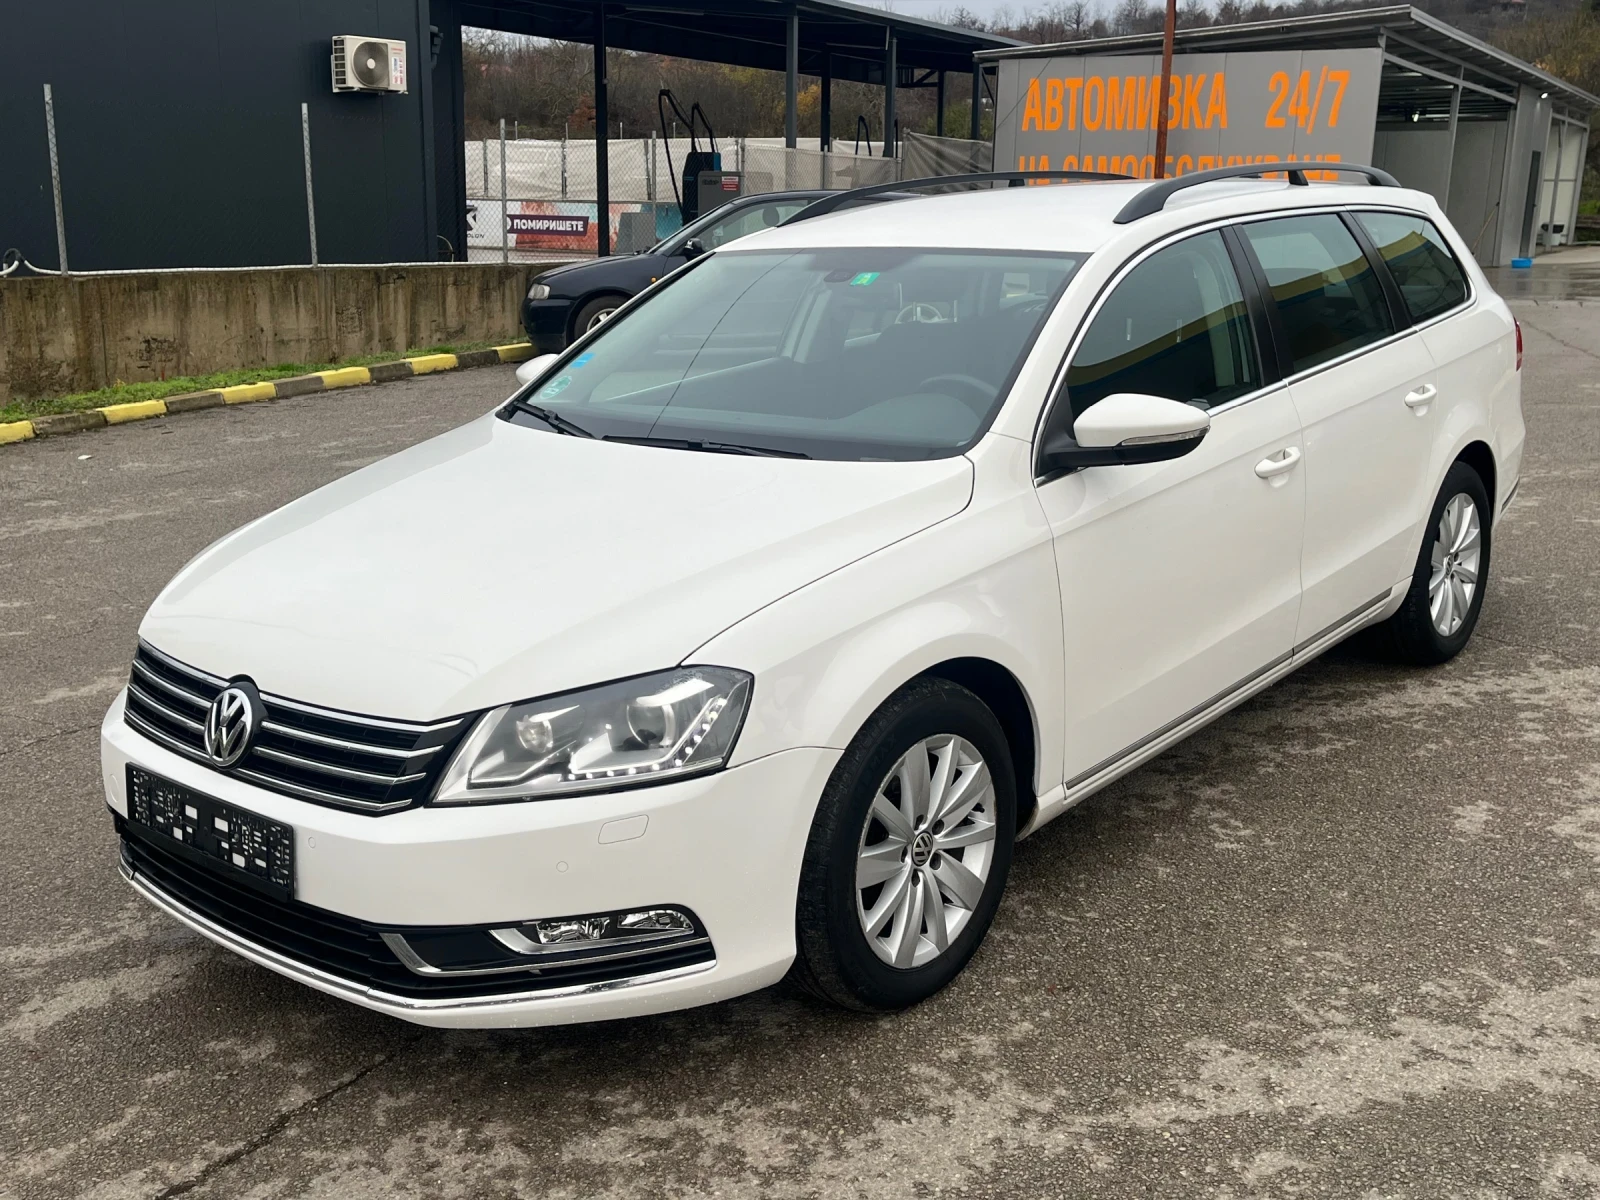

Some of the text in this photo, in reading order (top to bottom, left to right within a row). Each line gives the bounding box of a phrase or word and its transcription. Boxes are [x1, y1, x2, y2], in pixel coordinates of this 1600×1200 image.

[1021, 66, 1350, 134] АВТОМИВКА 24/7
[513, 219, 584, 231] ПОМИРИШЕТЕ
